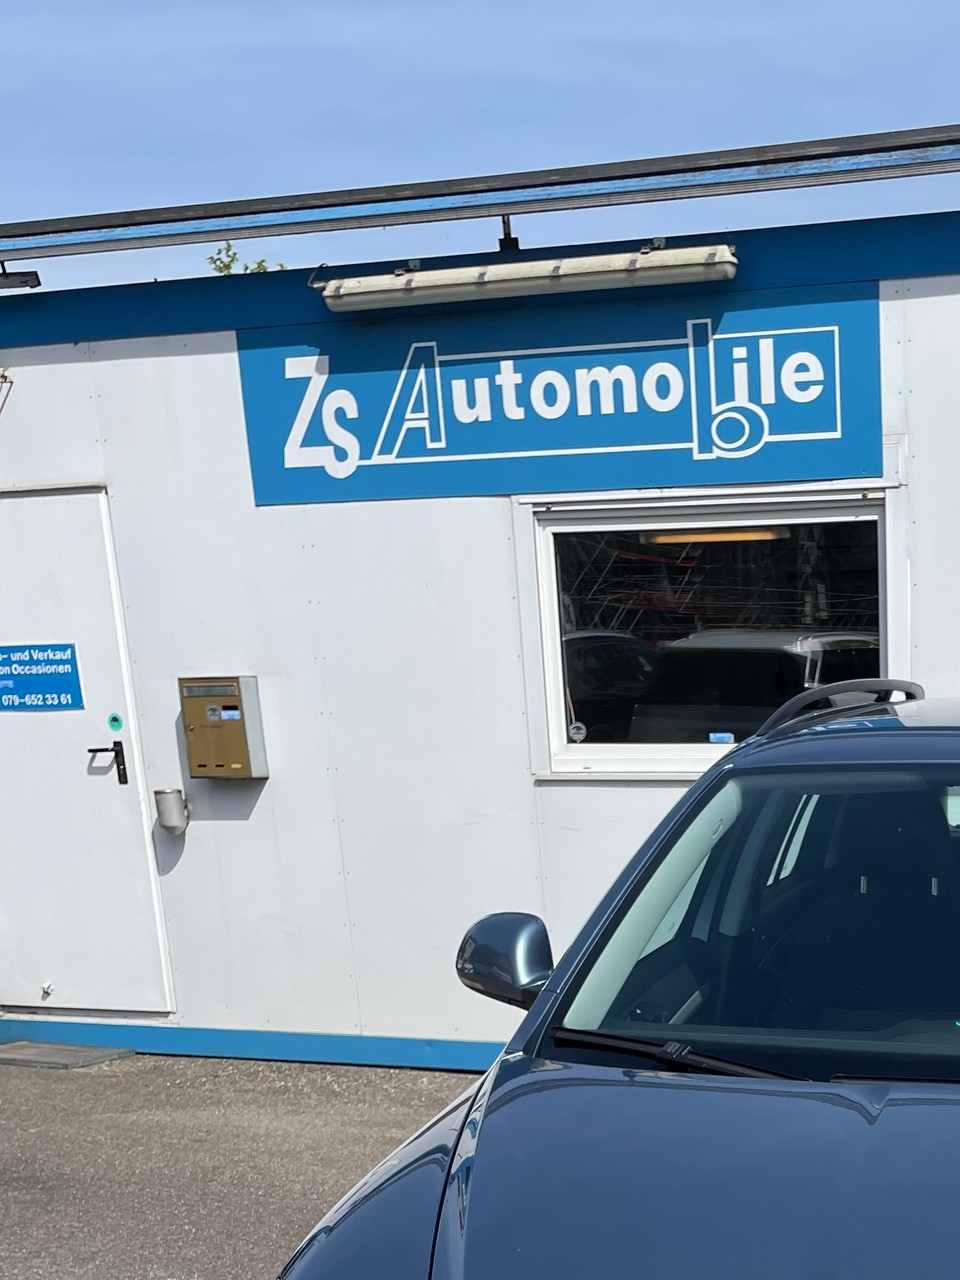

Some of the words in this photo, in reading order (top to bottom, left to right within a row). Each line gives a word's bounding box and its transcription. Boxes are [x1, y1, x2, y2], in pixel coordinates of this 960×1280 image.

[372, 319, 826, 460] Automobile
[10, 649, 30, 661] und
[31, 648, 72, 660] Verkauf
[11, 662, 72, 675] Occasionen
[2, 693, 44, 706] 079-652
[45, 693, 59, 705] 33
[60, 693, 72, 705] 61
